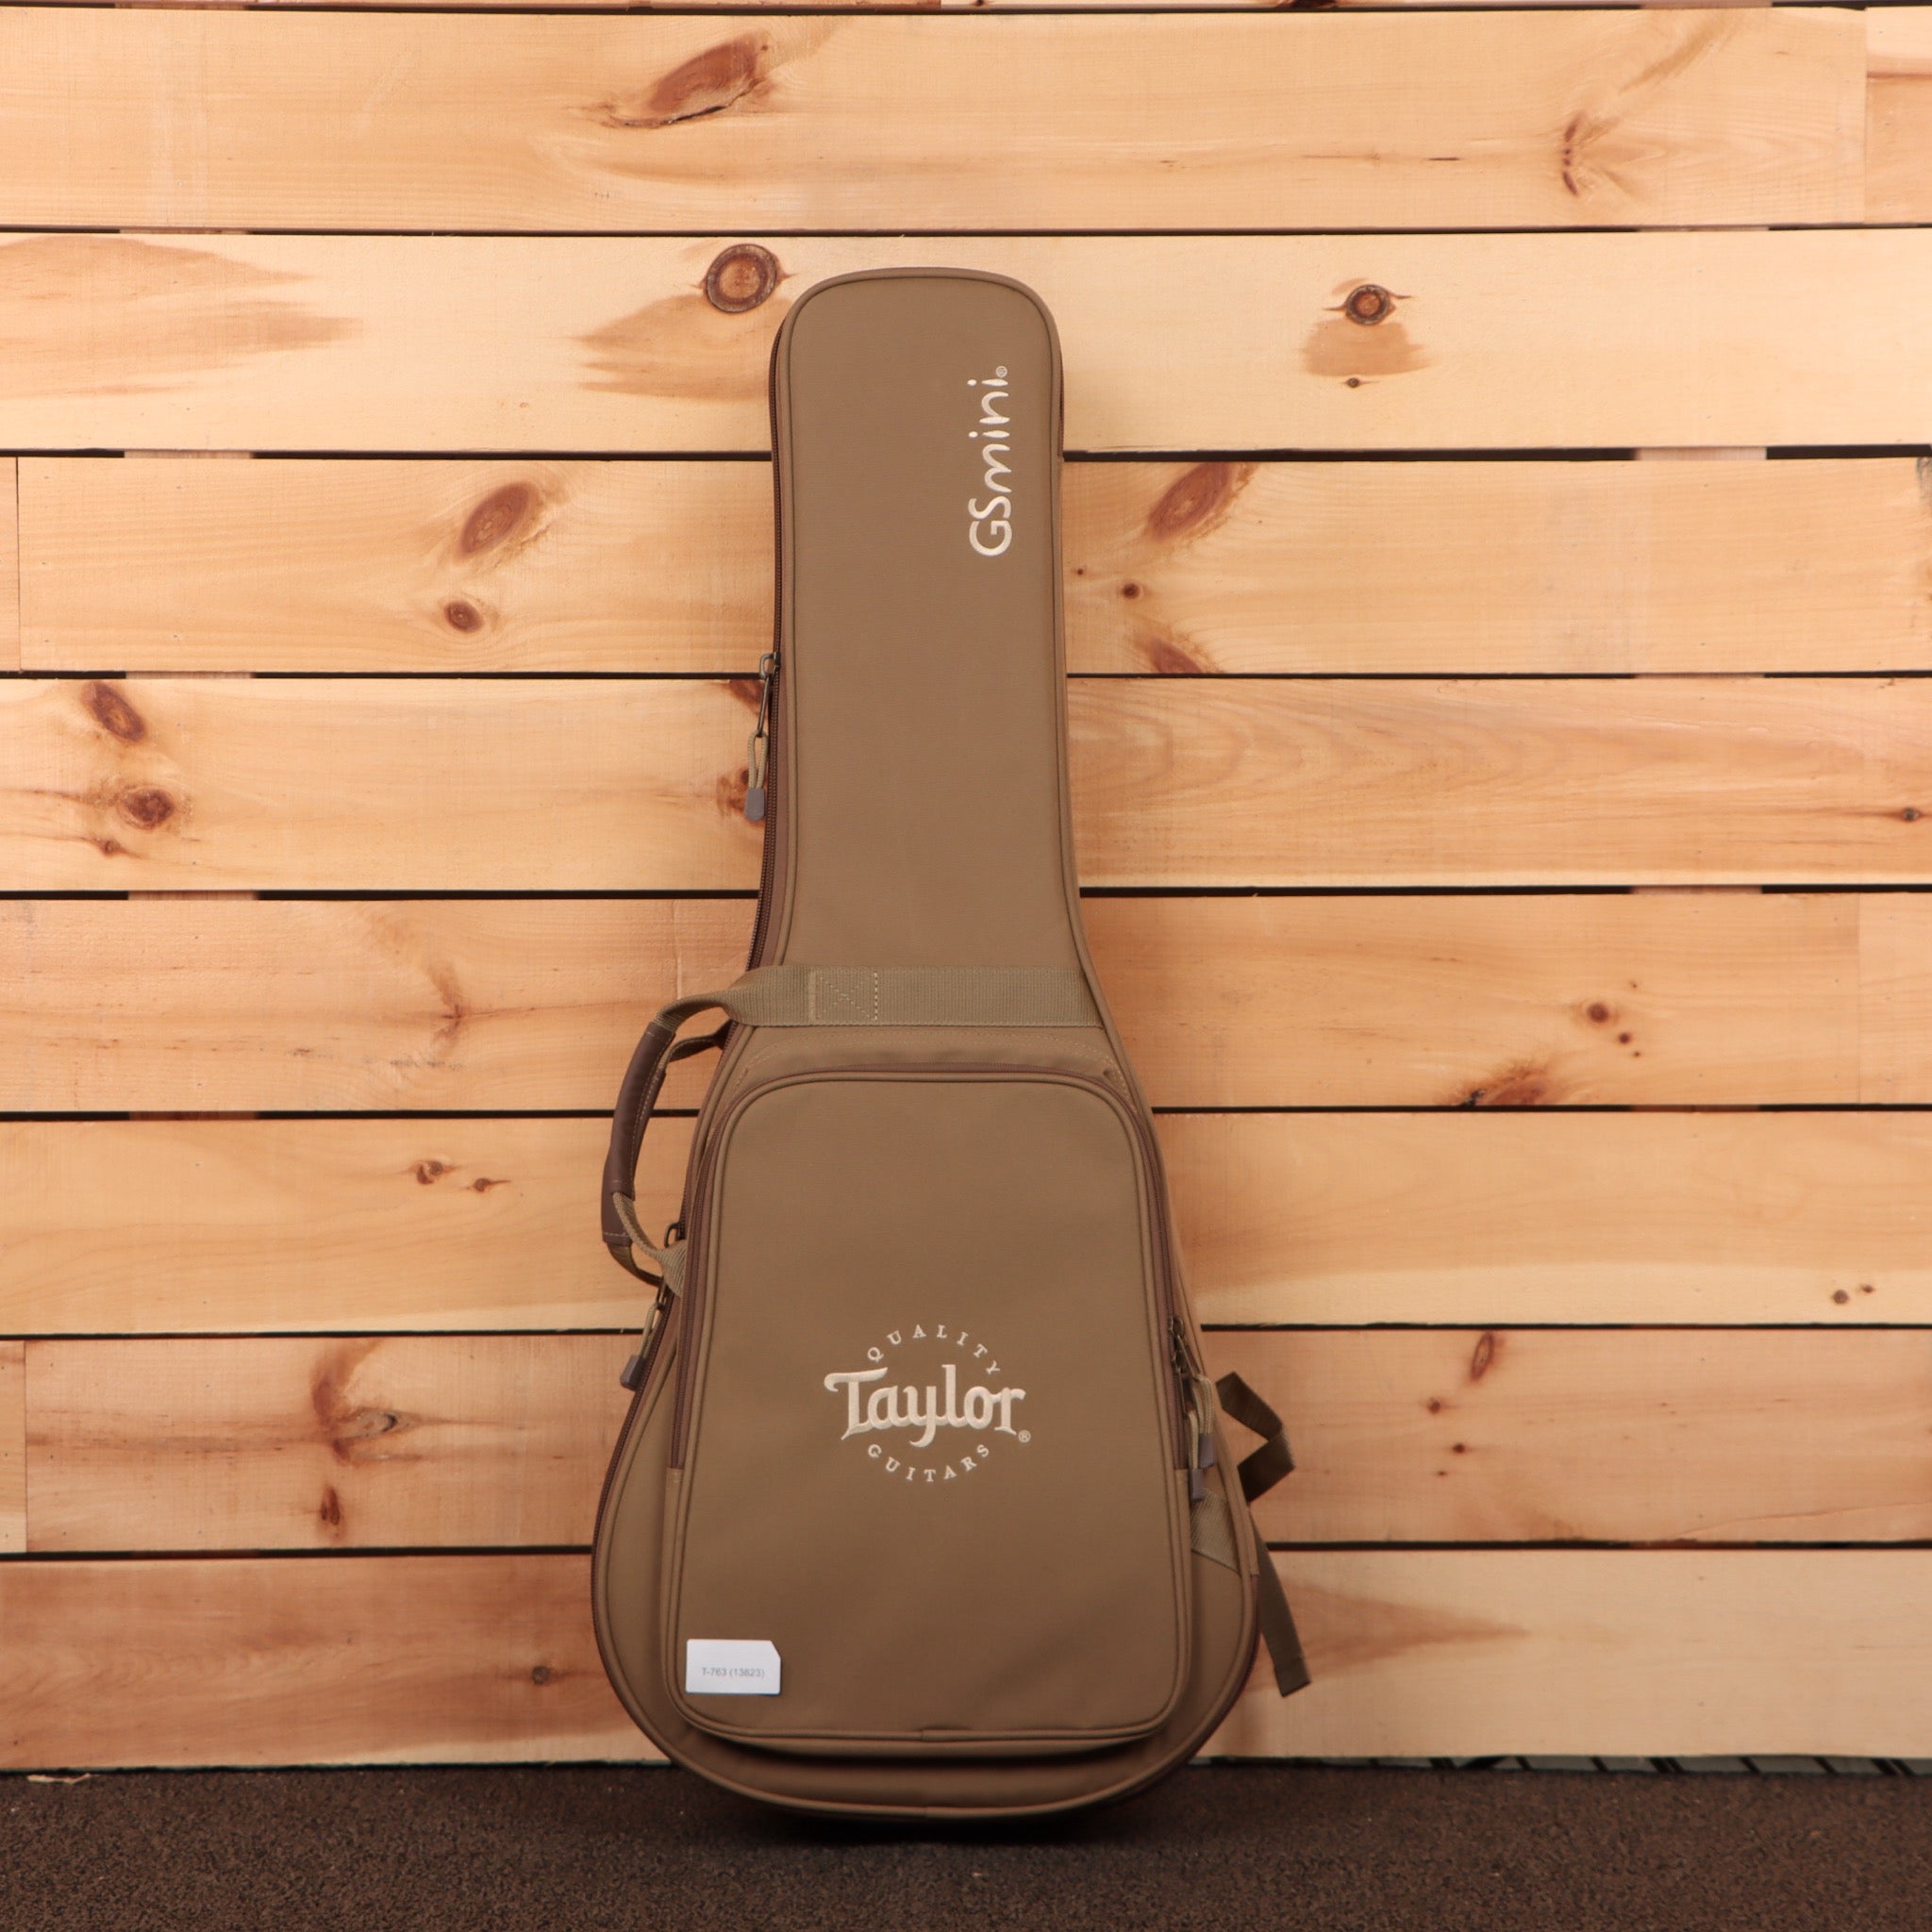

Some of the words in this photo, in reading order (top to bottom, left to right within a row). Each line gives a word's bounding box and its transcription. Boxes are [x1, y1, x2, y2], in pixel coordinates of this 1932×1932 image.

[867, 1324, 1001, 1375] QUALITY
[824, 1364, 1027, 1448] Taylor
[867, 1443, 990, 1483] GUITARS
[701, 1666, 727, 1676] T-763
